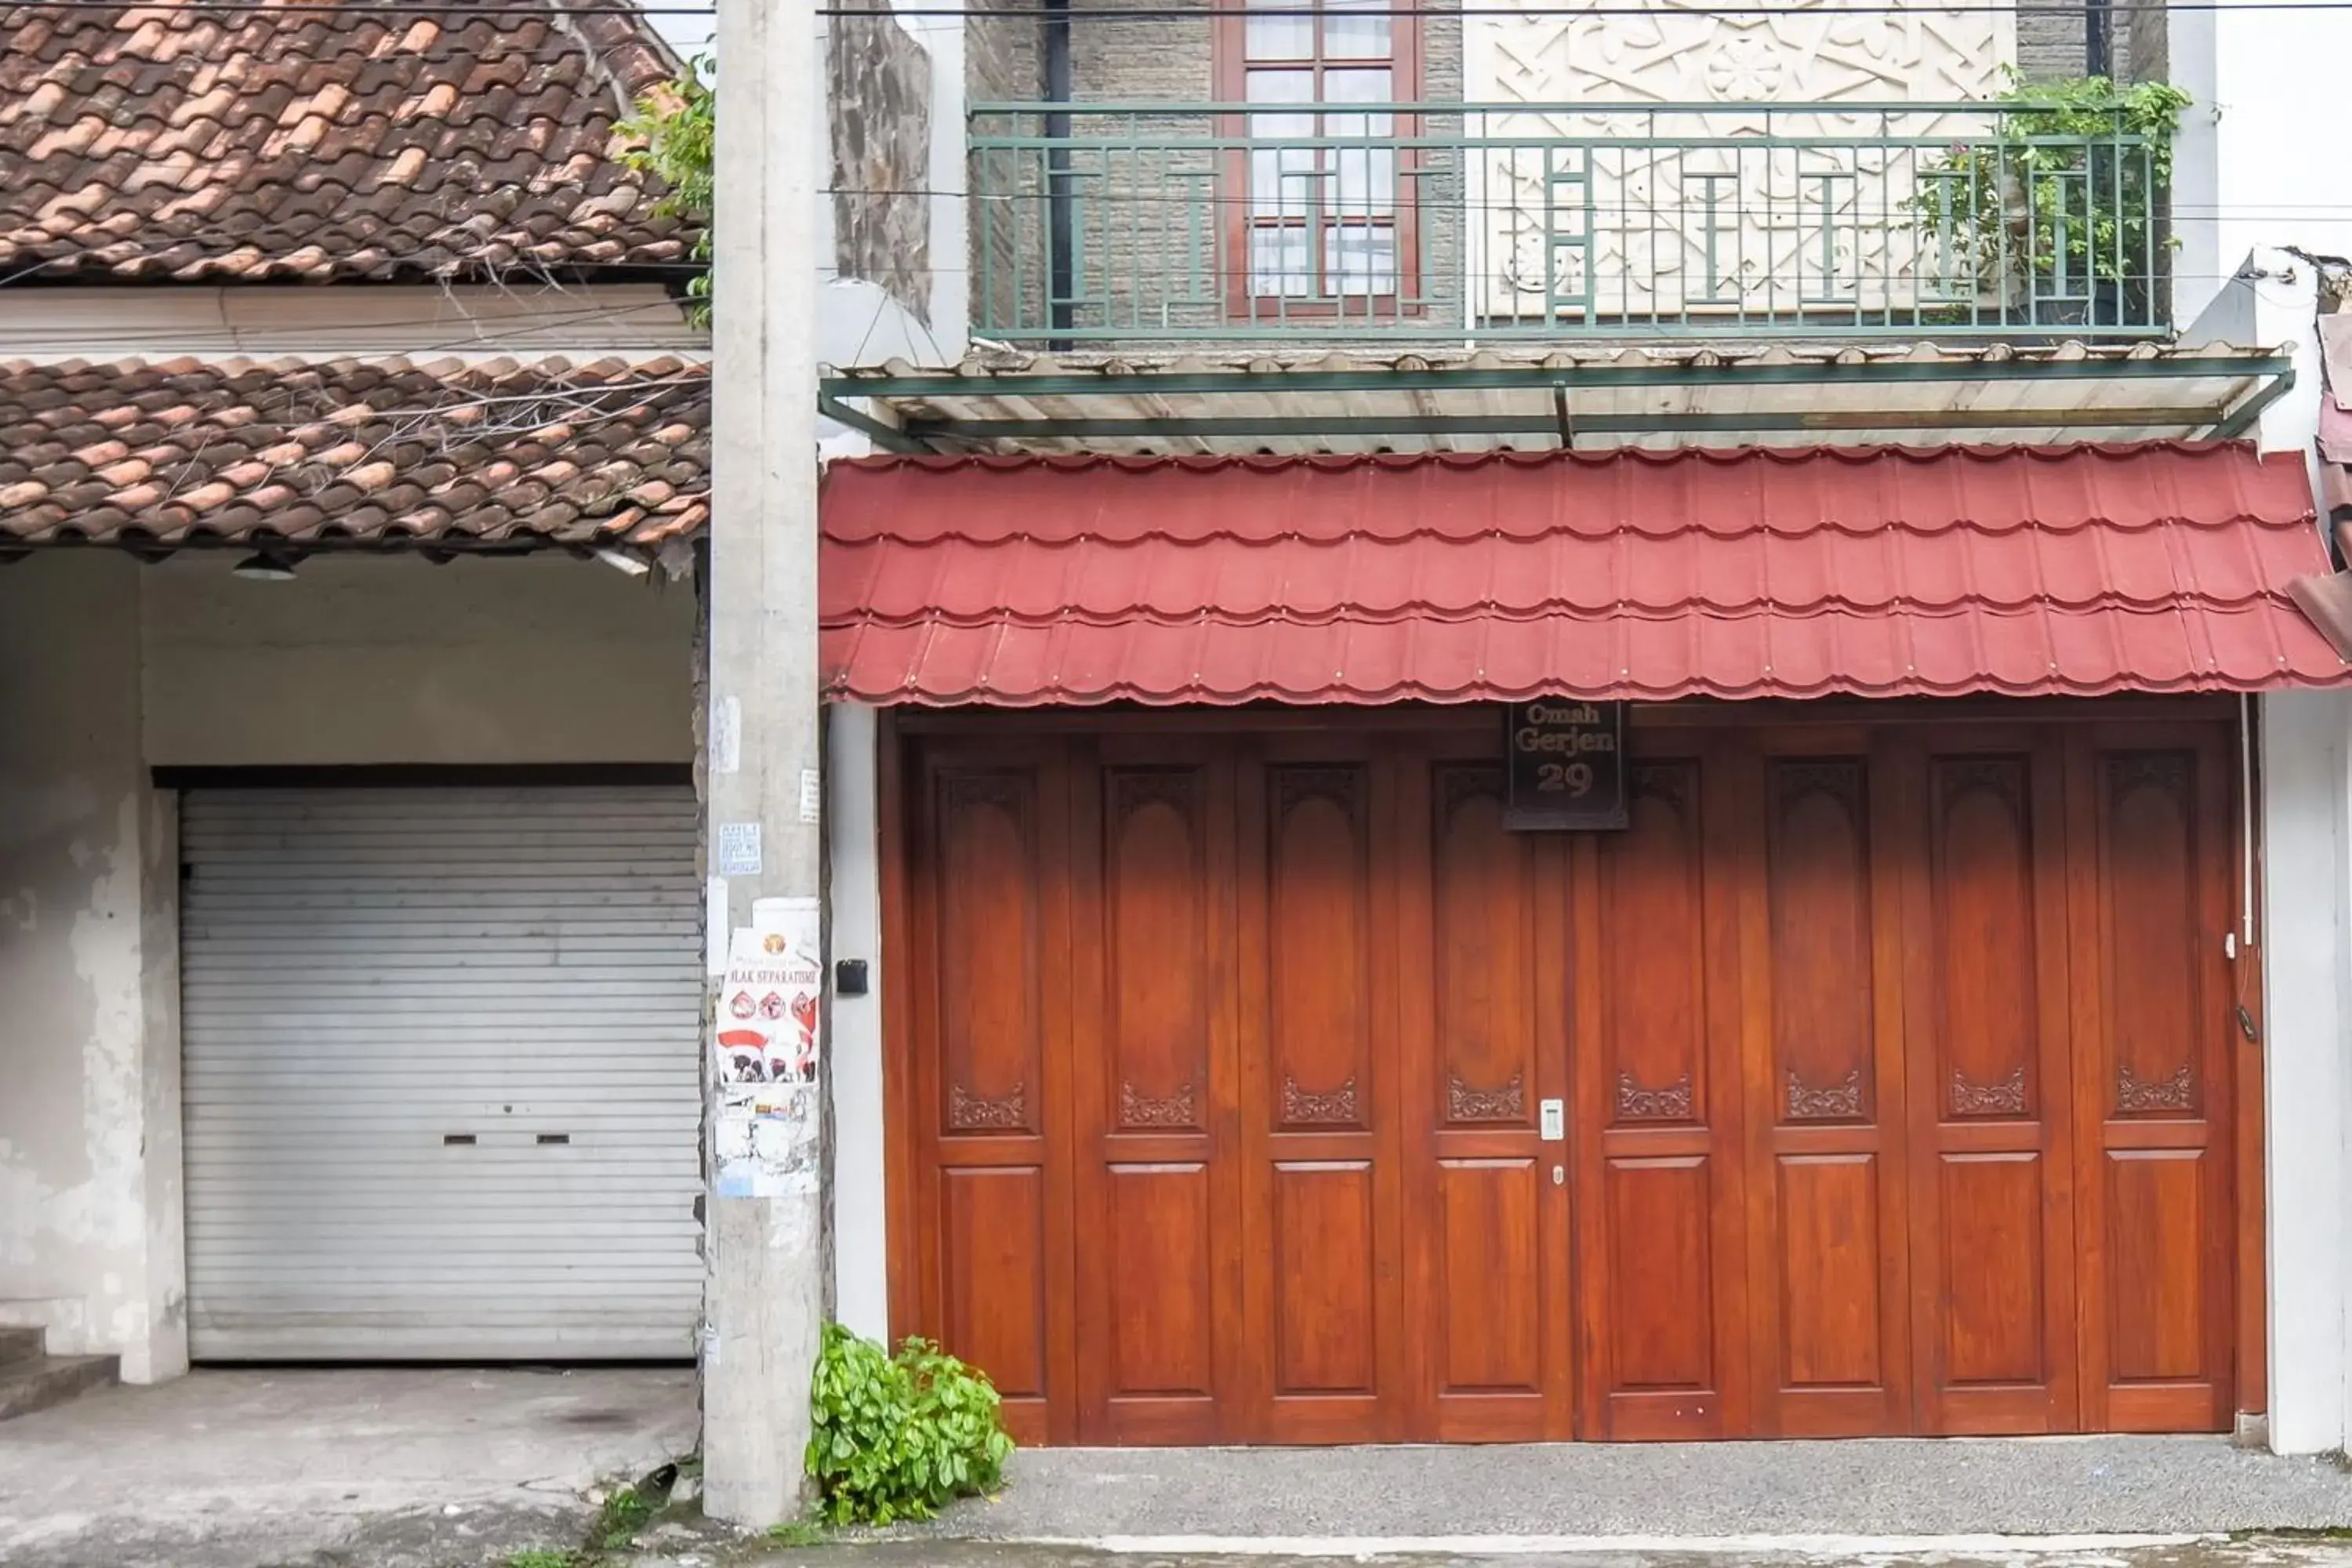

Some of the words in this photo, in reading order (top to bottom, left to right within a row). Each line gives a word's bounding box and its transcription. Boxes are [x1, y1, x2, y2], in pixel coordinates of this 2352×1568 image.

[1527, 703, 1600, 724] Omah
[1515, 727, 1614, 757] Gerjen
[1537, 762, 1594, 798] 29
